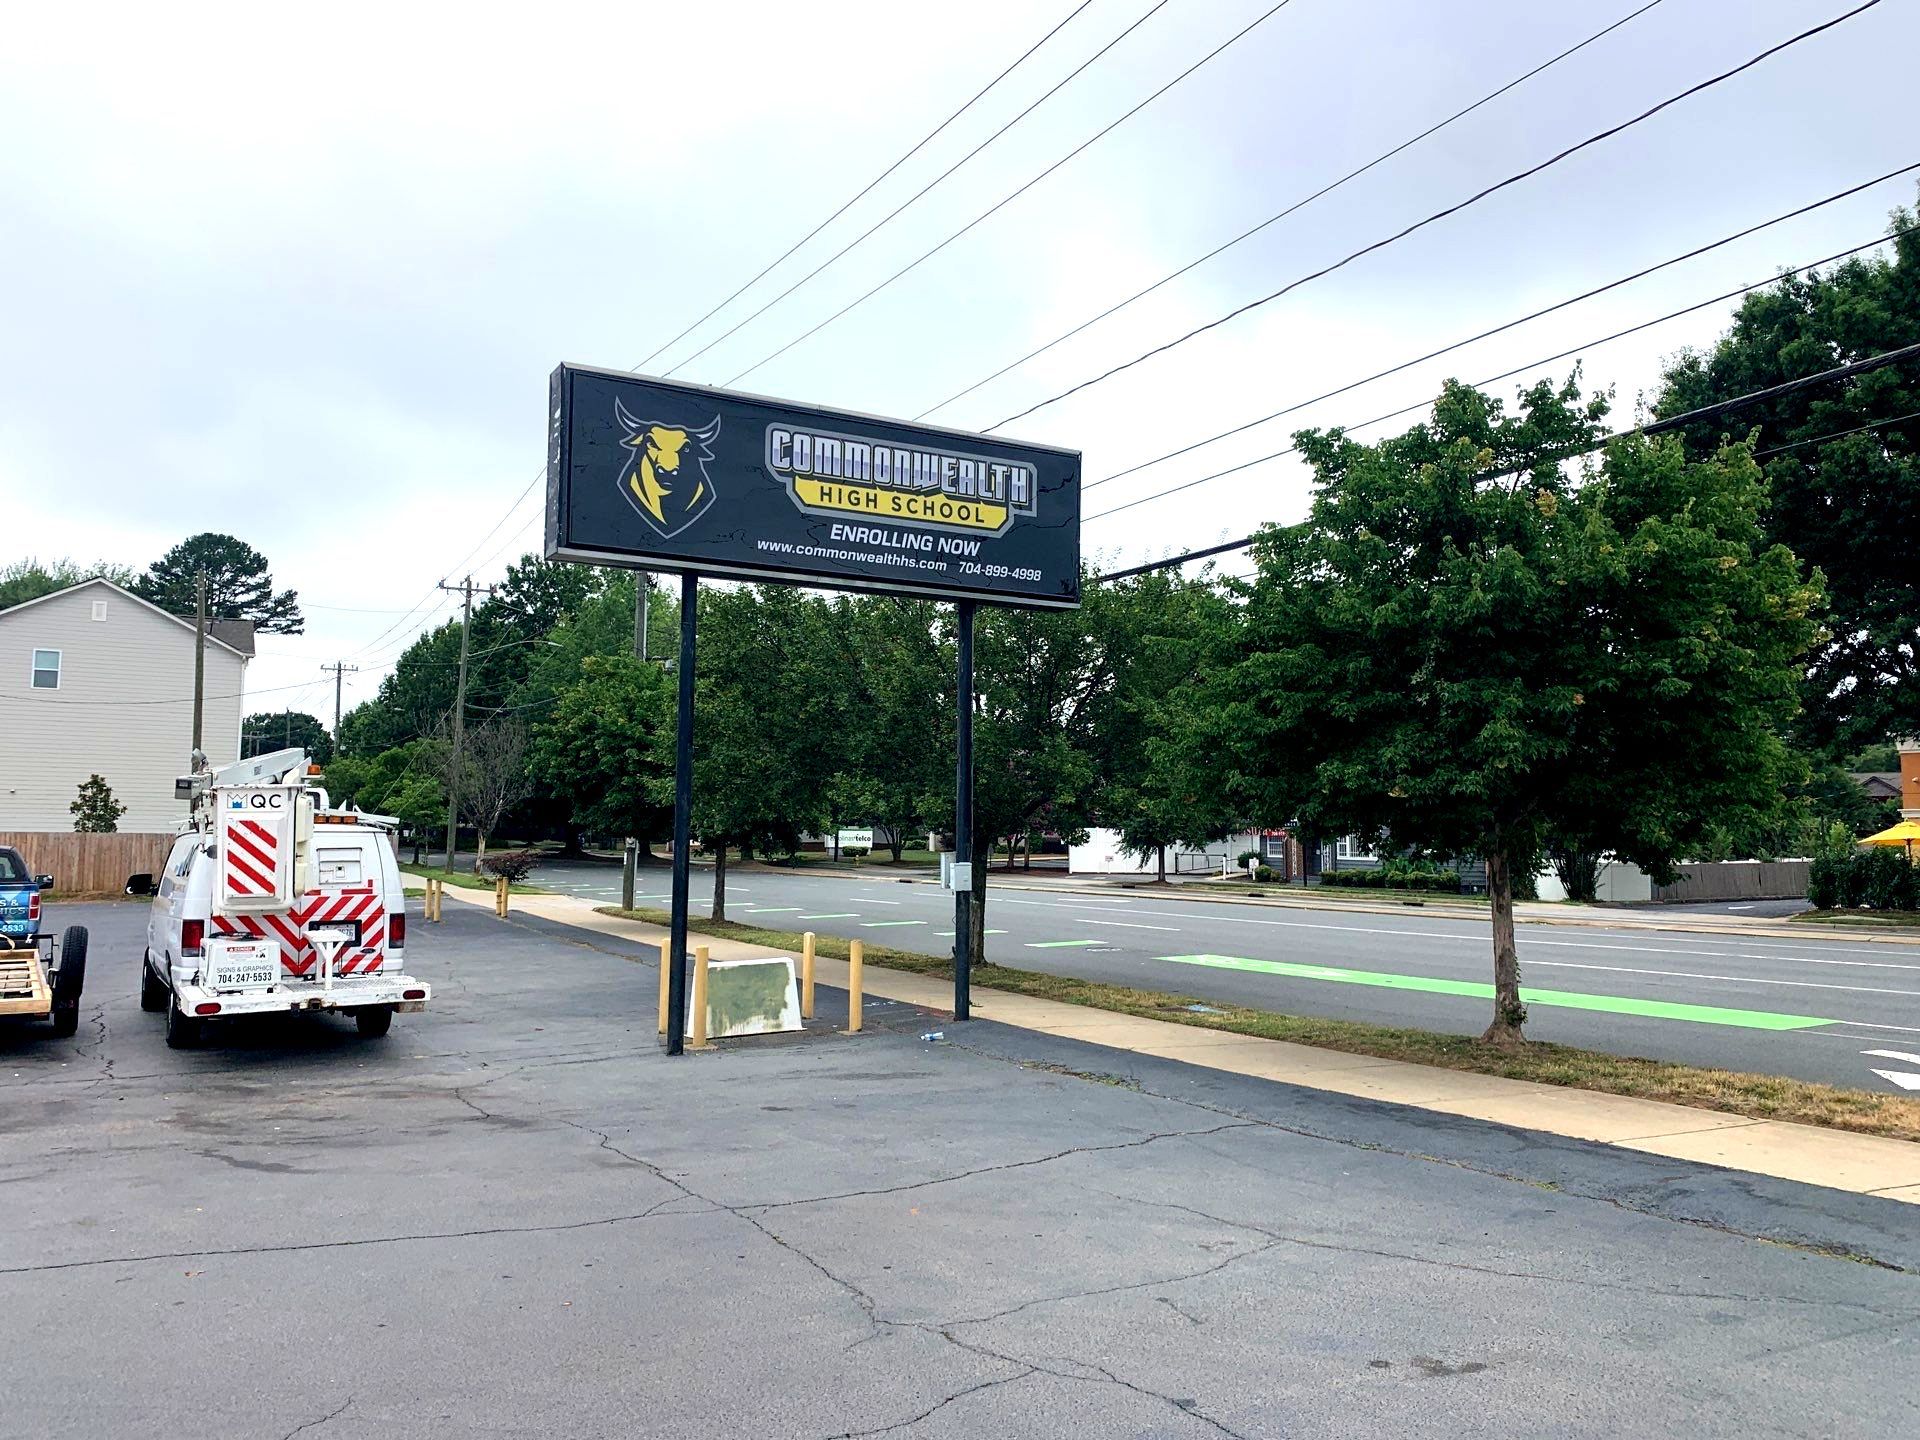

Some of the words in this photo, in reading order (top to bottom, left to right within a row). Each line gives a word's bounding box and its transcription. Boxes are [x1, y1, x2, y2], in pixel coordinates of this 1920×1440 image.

[771, 430, 1028, 504] COMMONWEALTH
[820, 486, 878, 509] HIGH
[891, 496, 985, 523] SCHOOL
[830, 523, 933, 551] ENROLLING
[937, 537, 982, 557] NOW
[757, 541, 947, 571] www.commonwealthhs.com
[959, 561, 1042, 581] 704-899-4998
[251, 794, 282, 808] QC
[216, 966, 236, 974] SIGNS
[242, 964, 274, 973] GRAPHICS
[217, 971, 272, 984] 704-247-5533
